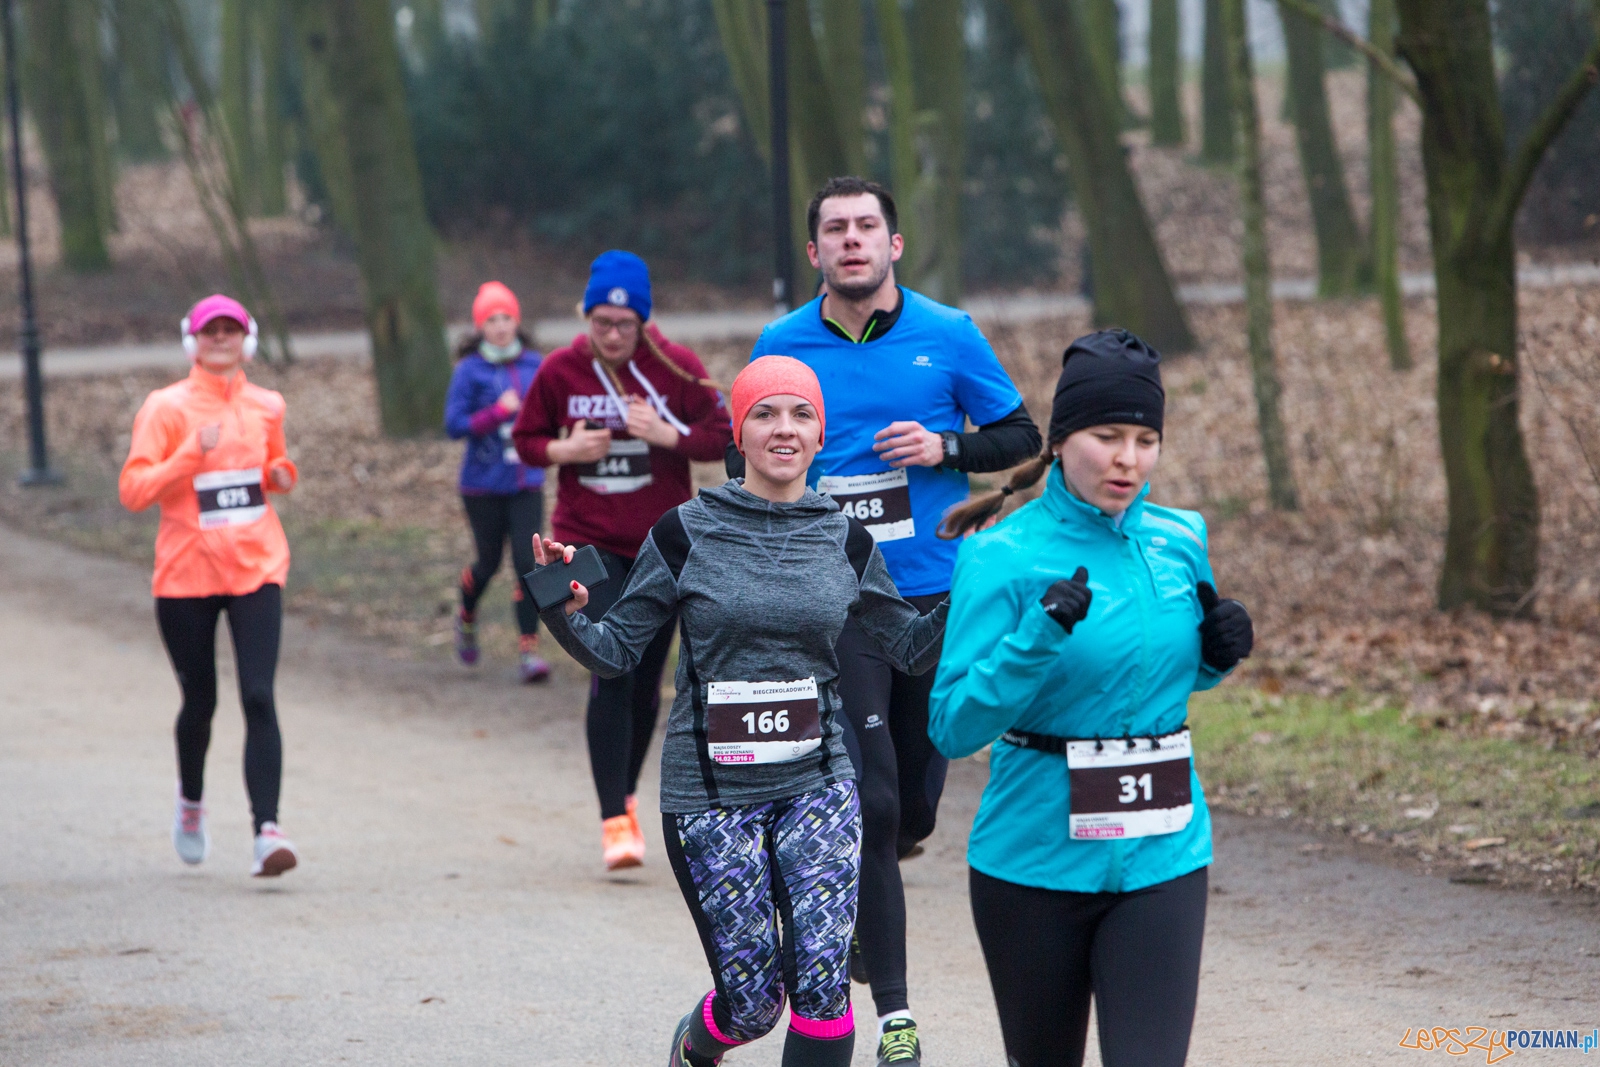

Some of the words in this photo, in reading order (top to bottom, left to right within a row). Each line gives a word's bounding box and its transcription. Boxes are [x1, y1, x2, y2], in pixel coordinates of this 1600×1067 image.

[217, 486, 250, 509] 675
[841, 498, 885, 520] 468
[753, 686, 813, 695] BIEGCZEKOLADOWY.PL
[741, 709, 790, 735] 166
[1118, 773, 1153, 804] 31
